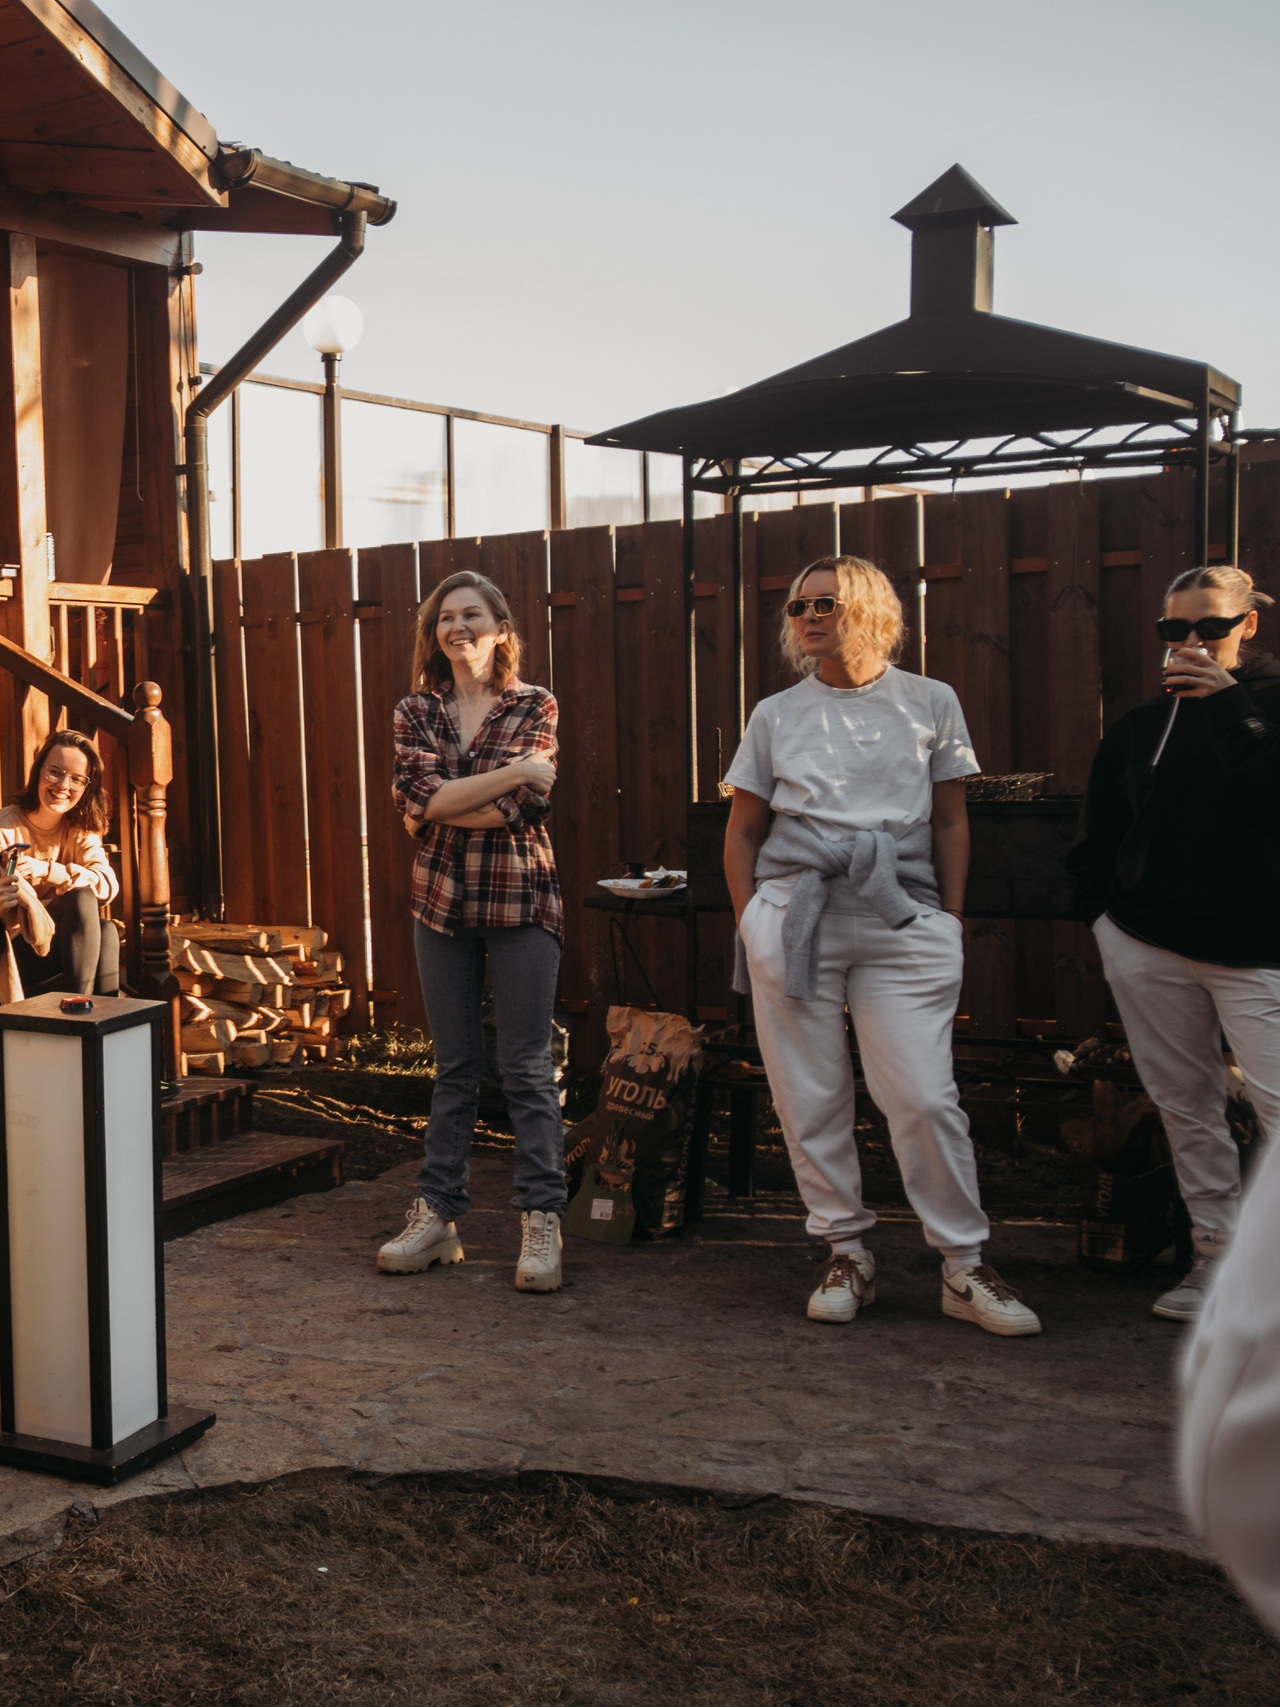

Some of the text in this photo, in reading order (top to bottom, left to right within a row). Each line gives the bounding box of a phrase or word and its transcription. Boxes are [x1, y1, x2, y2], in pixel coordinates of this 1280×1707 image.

[605, 1076, 667, 1111] УГОЛЬ
[605, 1101, 655, 1121] древесный
[562, 1136, 591, 1167] УГОЛ
